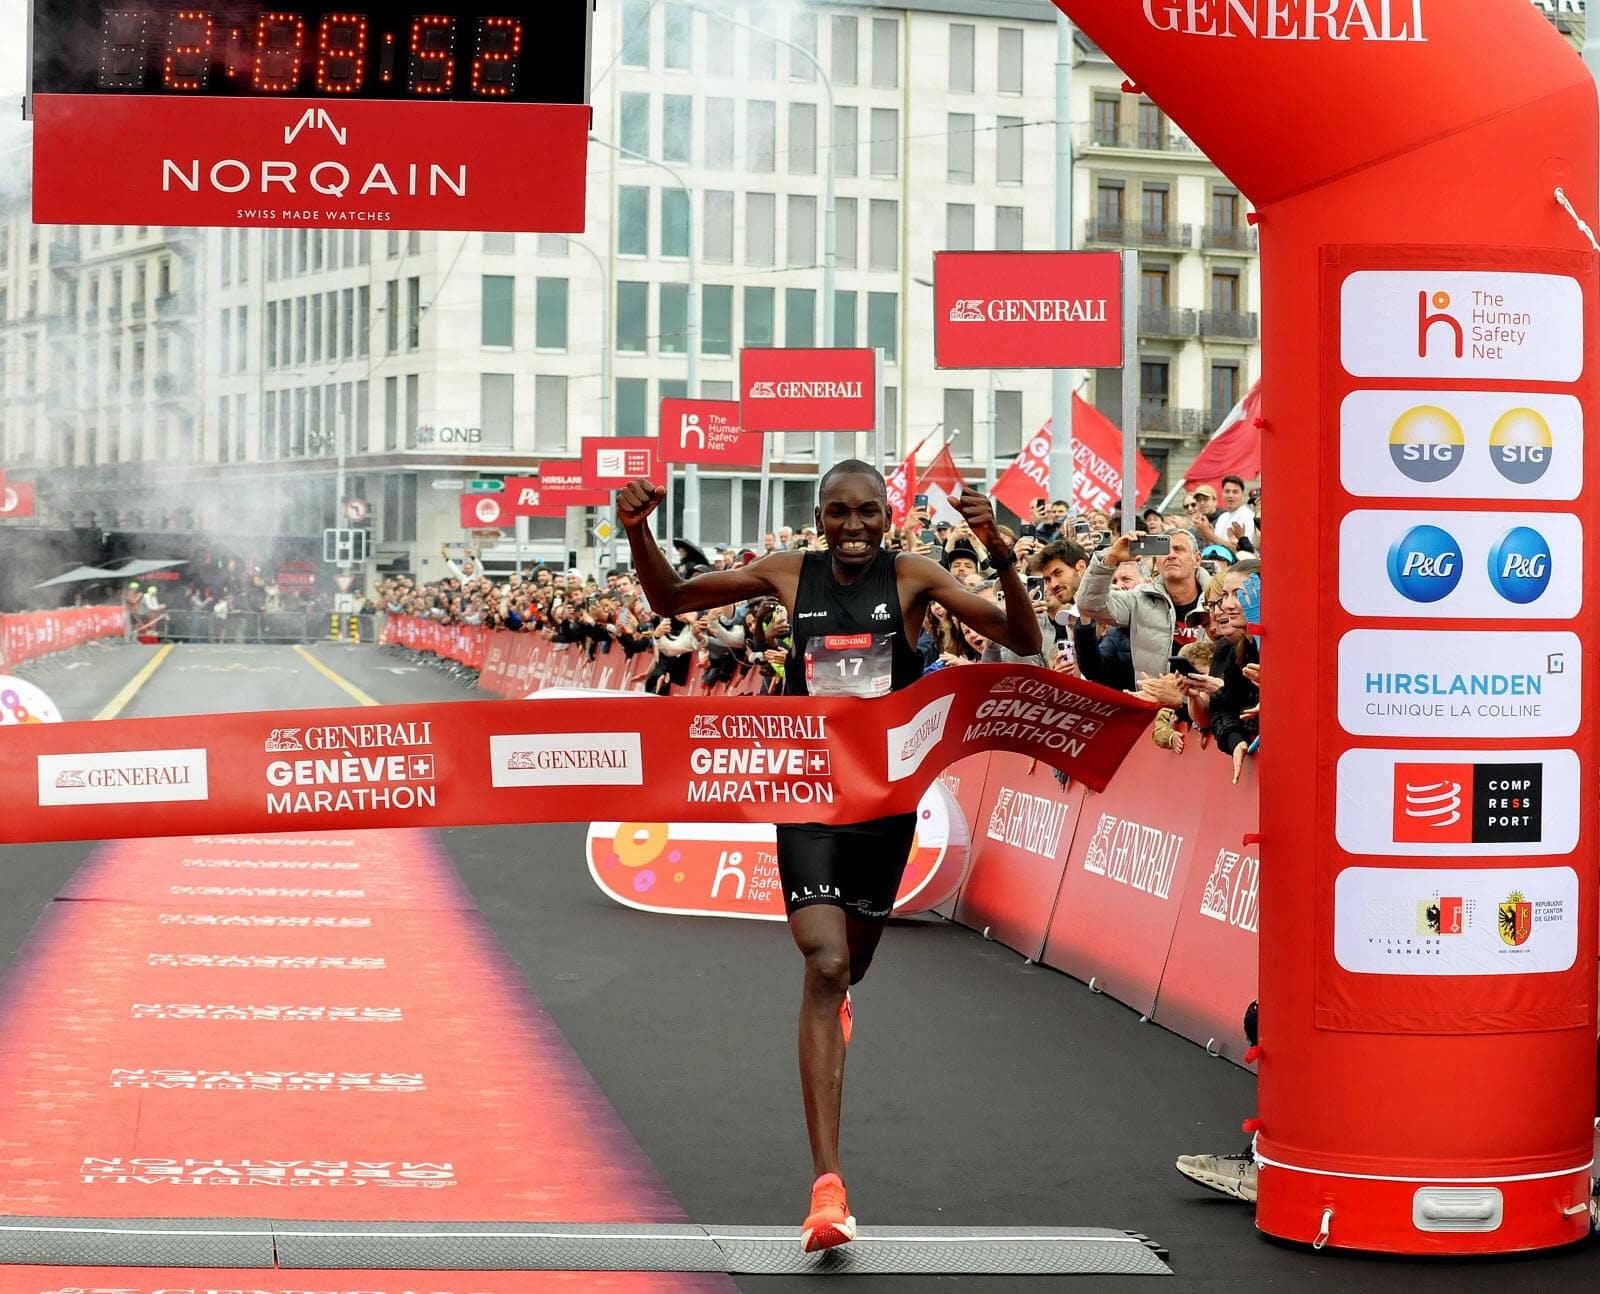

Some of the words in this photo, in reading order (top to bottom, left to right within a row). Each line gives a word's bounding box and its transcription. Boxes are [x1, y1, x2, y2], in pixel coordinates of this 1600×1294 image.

[1143, 0, 1428, 41] GENERALI
[163, 160, 466, 197] NORQAIN
[237, 209, 276, 219] SWISS
[282, 210, 319, 220] MADE
[325, 211, 391, 221] WATCHES
[1472, 290, 1504, 307] The
[988, 300, 1107, 322] GENERALI
[1472, 309, 1531, 325] Human
[1472, 327, 1526, 346] Safety
[1472, 344, 1503, 359] Net
[776, 381, 862, 398] GENERALI
[708, 414, 727, 425] The
[439, 427, 482, 443] QNB
[707, 441, 726, 450] Net
[1403, 445, 1453, 461] SIG
[1502, 446, 1544, 463] SIG
[1402, 552, 1456, 577] P&G
[1502, 553, 1546, 578] P&G
[836, 658, 863, 677] 17
[1366, 673, 1541, 695] HIRSLANDEN
[1018, 678, 1121, 717] GENERALI
[975, 699, 1081, 732] GENÈVE
[1366, 703, 1444, 717] CLINIQUE
[1450, 704, 1471, 717] LA
[1477, 704, 1541, 717] COLLINE
[304, 721, 432, 750] GENERALI
[721, 715, 827, 740] GENERALI
[962, 724, 1086, 758] MARATHON
[537, 749, 627, 769] GENERALI
[690, 741, 804, 775] GENÈVE
[87, 766, 190, 787] GENERALI
[266, 751, 405, 787] GENÈVE
[687, 780, 834, 804] MARATHON
[1488, 780, 1531, 791] COMP
[267, 785, 435, 814] MARATHON
[1488, 798, 1530, 809] RESS
[1005, 791, 1068, 859] GENERALI
[1488, 816, 1529, 827] PORT
[757, 851, 778, 865] The
[1107, 819, 1183, 899] GENERALI
[747, 888, 771, 901] Net
[82, 1156, 455, 1170] MARATHON
[78, 1175, 367, 1186] GENERALI
